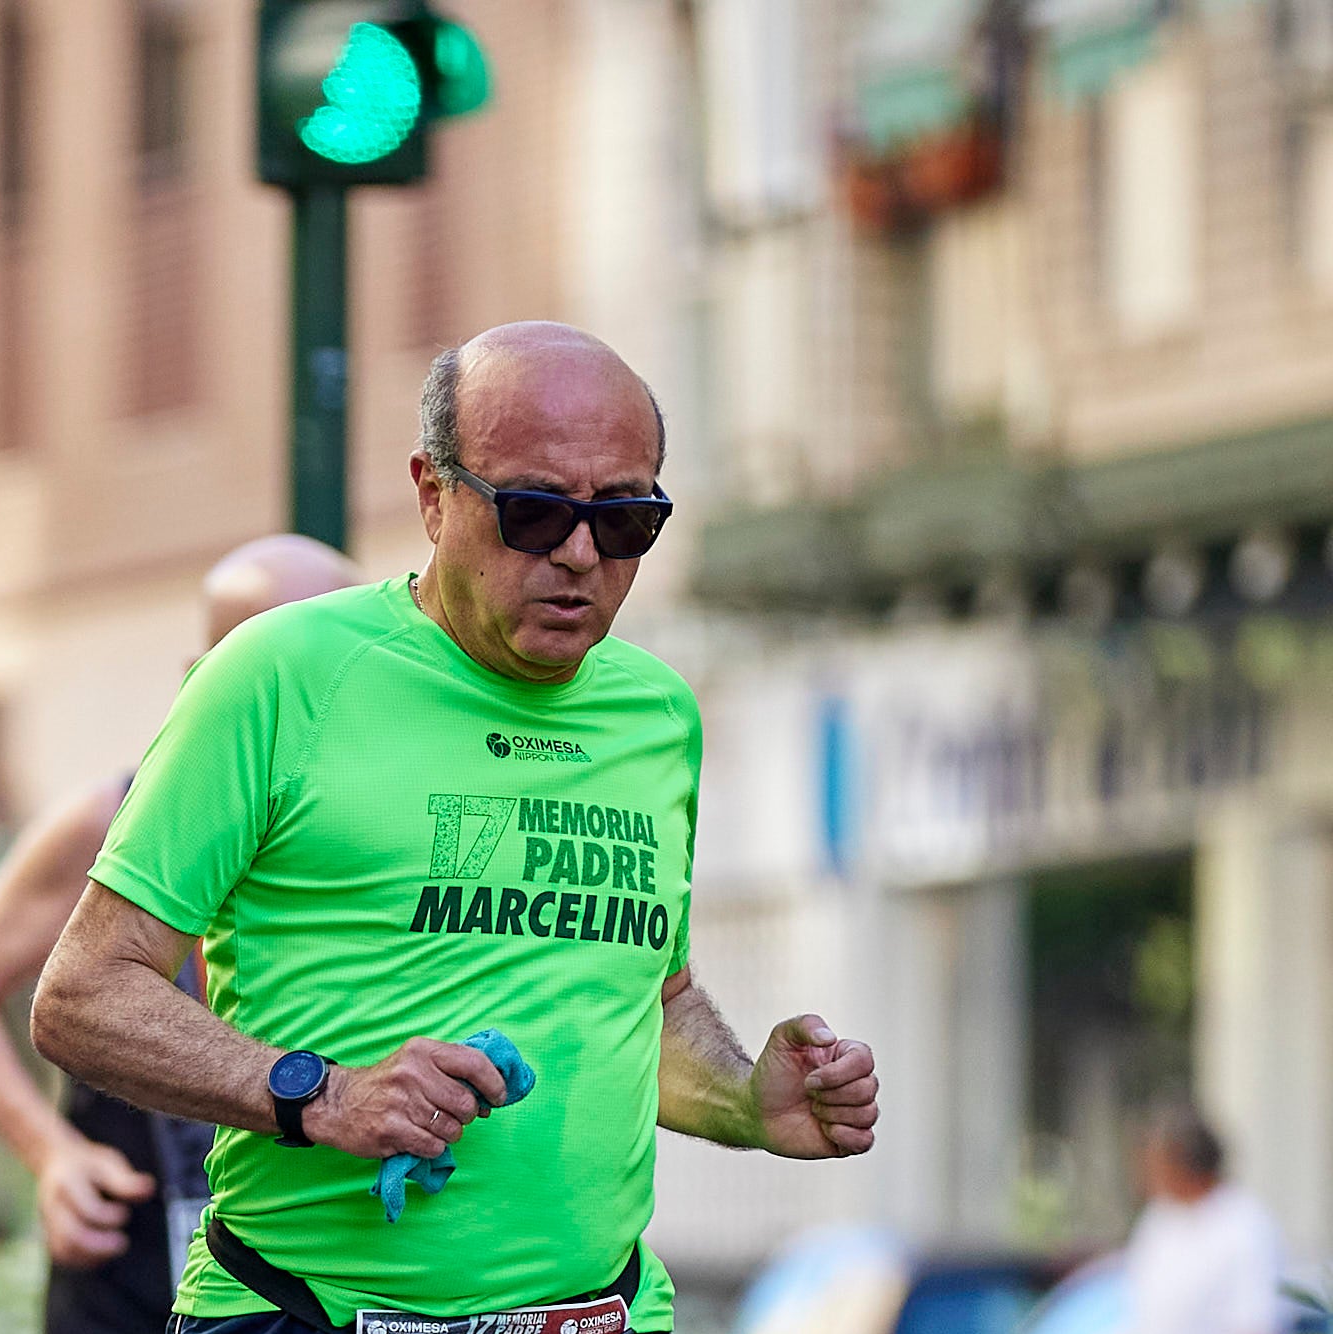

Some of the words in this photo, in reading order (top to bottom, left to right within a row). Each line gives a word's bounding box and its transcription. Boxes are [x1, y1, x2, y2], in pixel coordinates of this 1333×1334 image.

[513, 735, 585, 755] OXIMESA
[514, 750, 554, 762] NIPPON
[557, 753, 592, 763] GASES
[518, 798, 658, 850] MEMORIAL
[428, 794, 517, 879] 17
[522, 836, 656, 895] PADRE
[409, 886, 669, 951] MARCELINO
[388, 1321, 449, 1333] OXIMESA
[496, 1312, 548, 1325] MEMORIAL
[579, 1311, 622, 1328] OXIMESA
